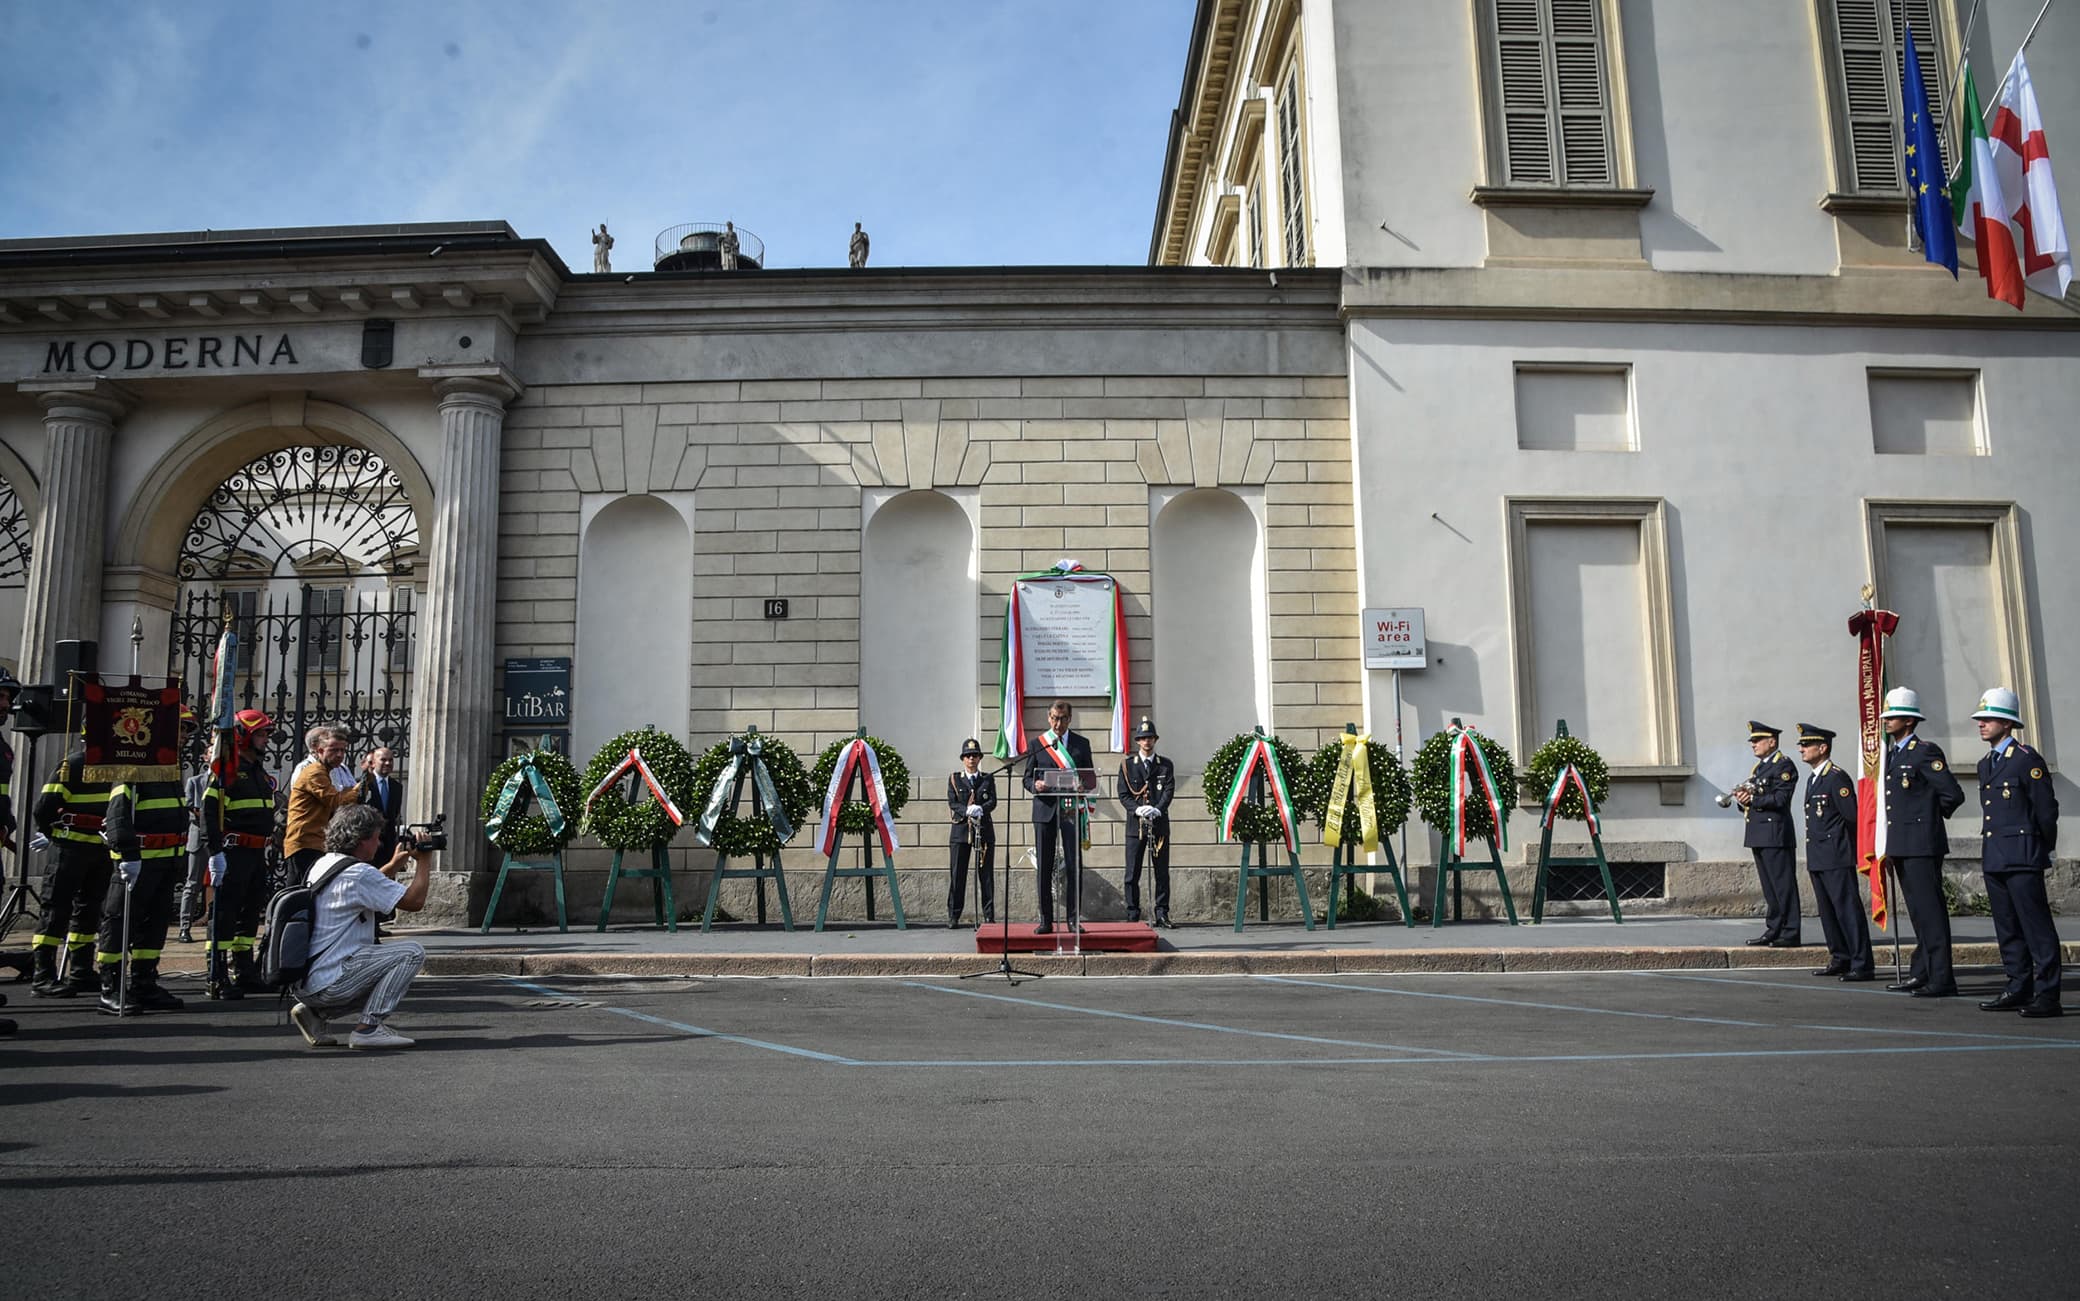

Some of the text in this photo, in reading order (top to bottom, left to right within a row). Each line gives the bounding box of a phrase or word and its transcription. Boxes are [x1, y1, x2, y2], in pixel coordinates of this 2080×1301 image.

[42, 333, 299, 373] MODERNA
[768, 601, 783, 615] 16
[1377, 621, 1410, 631] Wi-Fi
[1378, 633, 1410, 641] area
[1862, 648, 1876, 734] POLIZIA MUNICIPALE
[116, 750, 147, 759] MILANO
